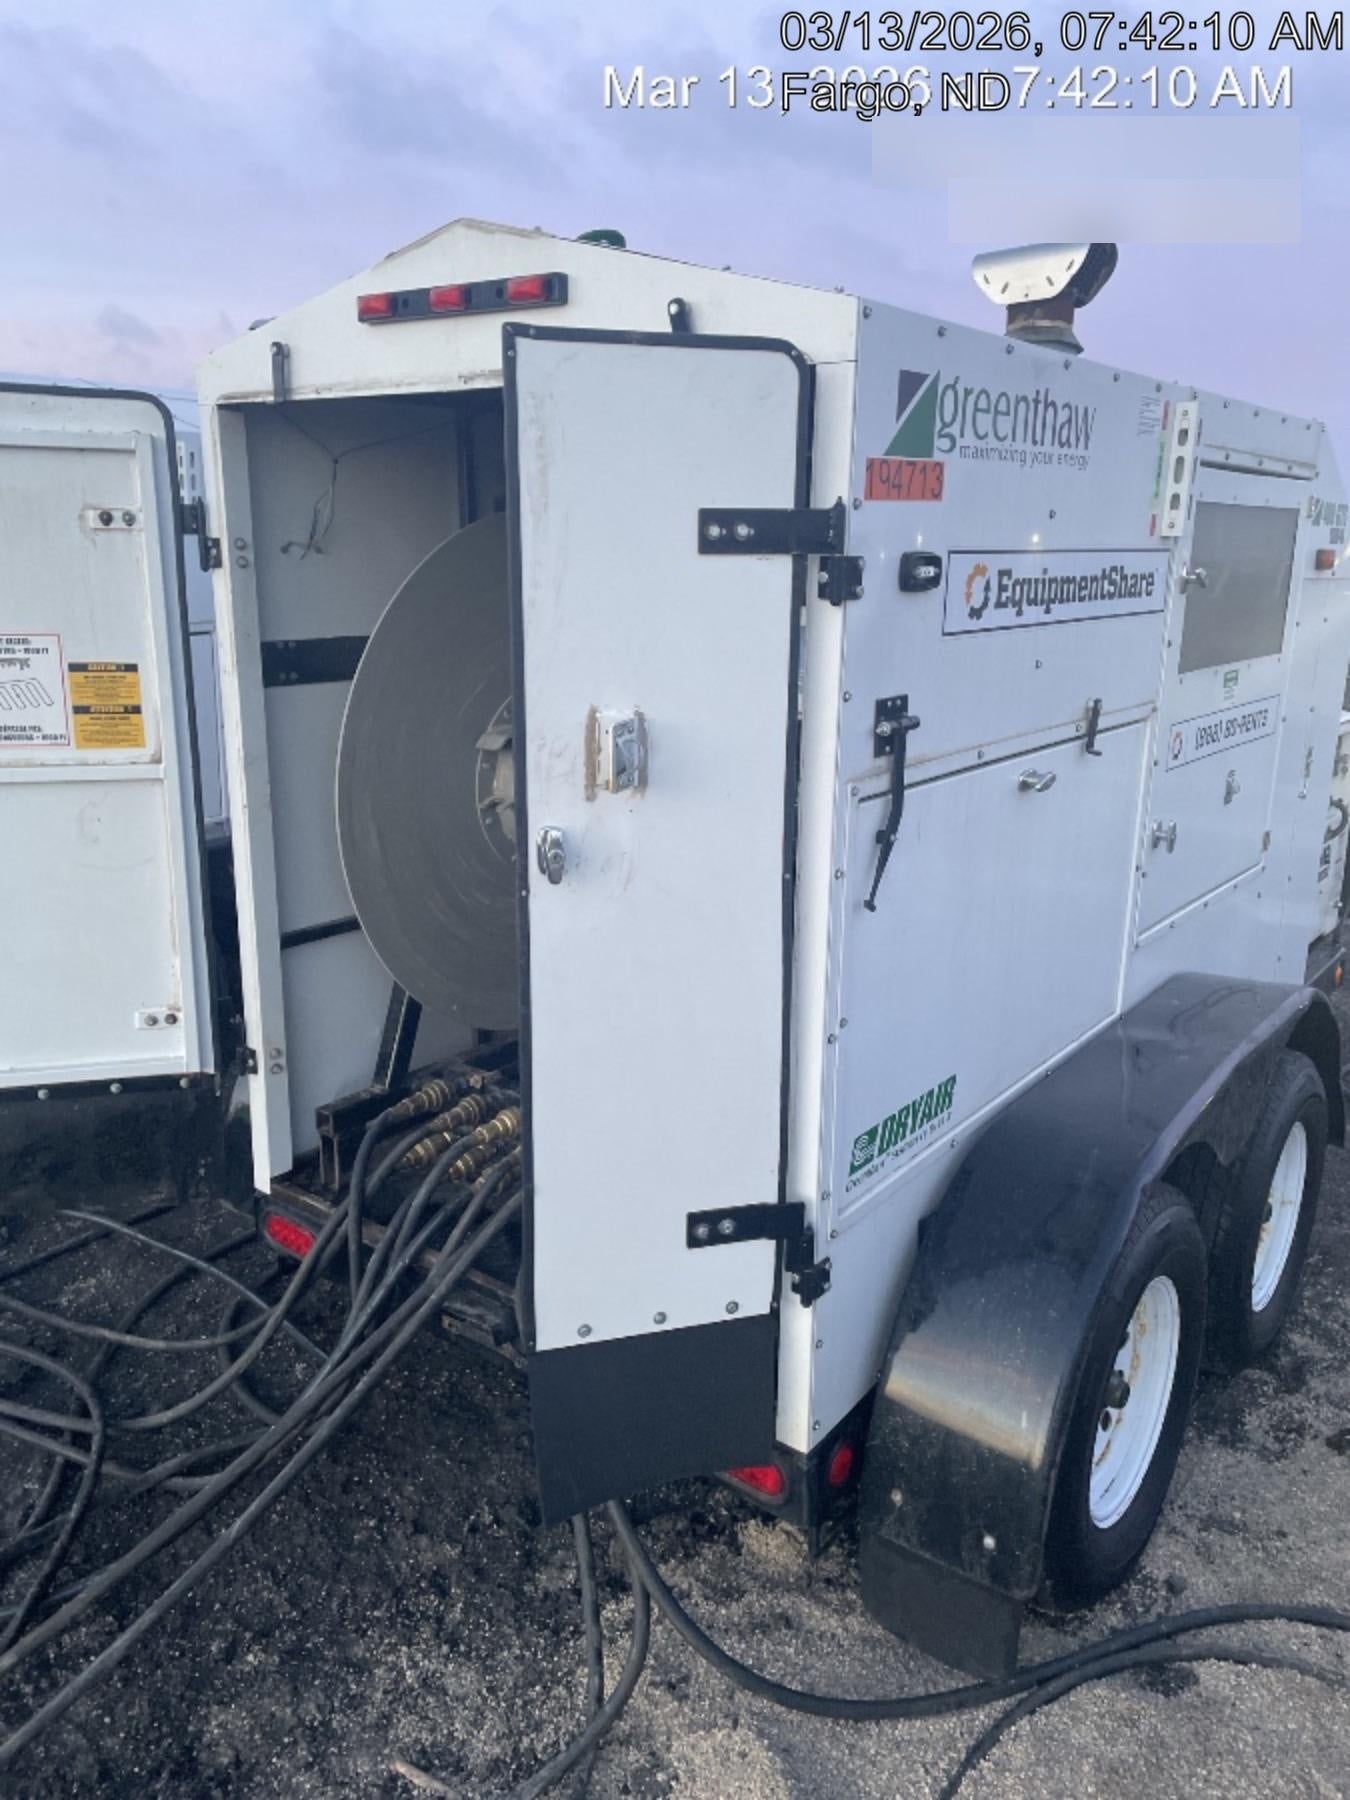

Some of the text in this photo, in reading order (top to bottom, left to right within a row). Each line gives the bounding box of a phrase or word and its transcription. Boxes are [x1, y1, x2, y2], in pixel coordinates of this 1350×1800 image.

[936, 376, 1096, 452] greenthaw
[865, 458, 944, 500] 194713
[994, 565, 1155, 617] EquipmentShare
